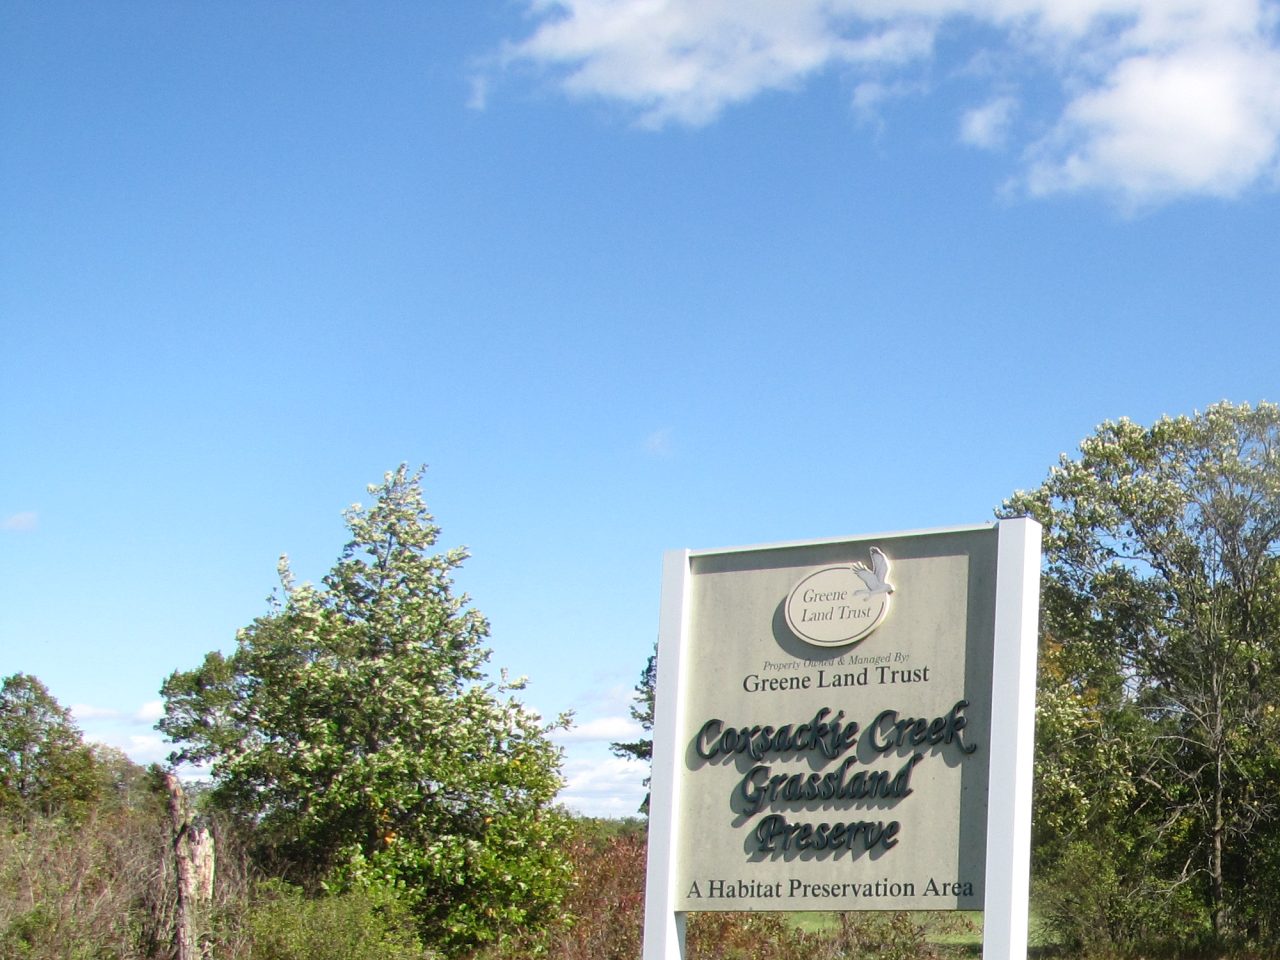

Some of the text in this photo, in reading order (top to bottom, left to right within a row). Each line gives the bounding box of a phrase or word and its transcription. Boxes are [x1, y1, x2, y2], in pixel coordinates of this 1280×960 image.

[803, 589, 848, 603] Greene
[801, 605, 872, 622] Land Trust
[763, 660, 801, 671] Property
[803, 657, 835, 667] Owned
[838, 656, 846, 666] &
[848, 653, 891, 665] Managed
[743, 664, 930, 692] Greene Land Trust
[696, 700, 976, 761] Coxsackie Creek
[741, 755, 923, 816] Grassland
[755, 814, 900, 851] Preserve
[687, 877, 974, 898] A Habitat Preservation Area
